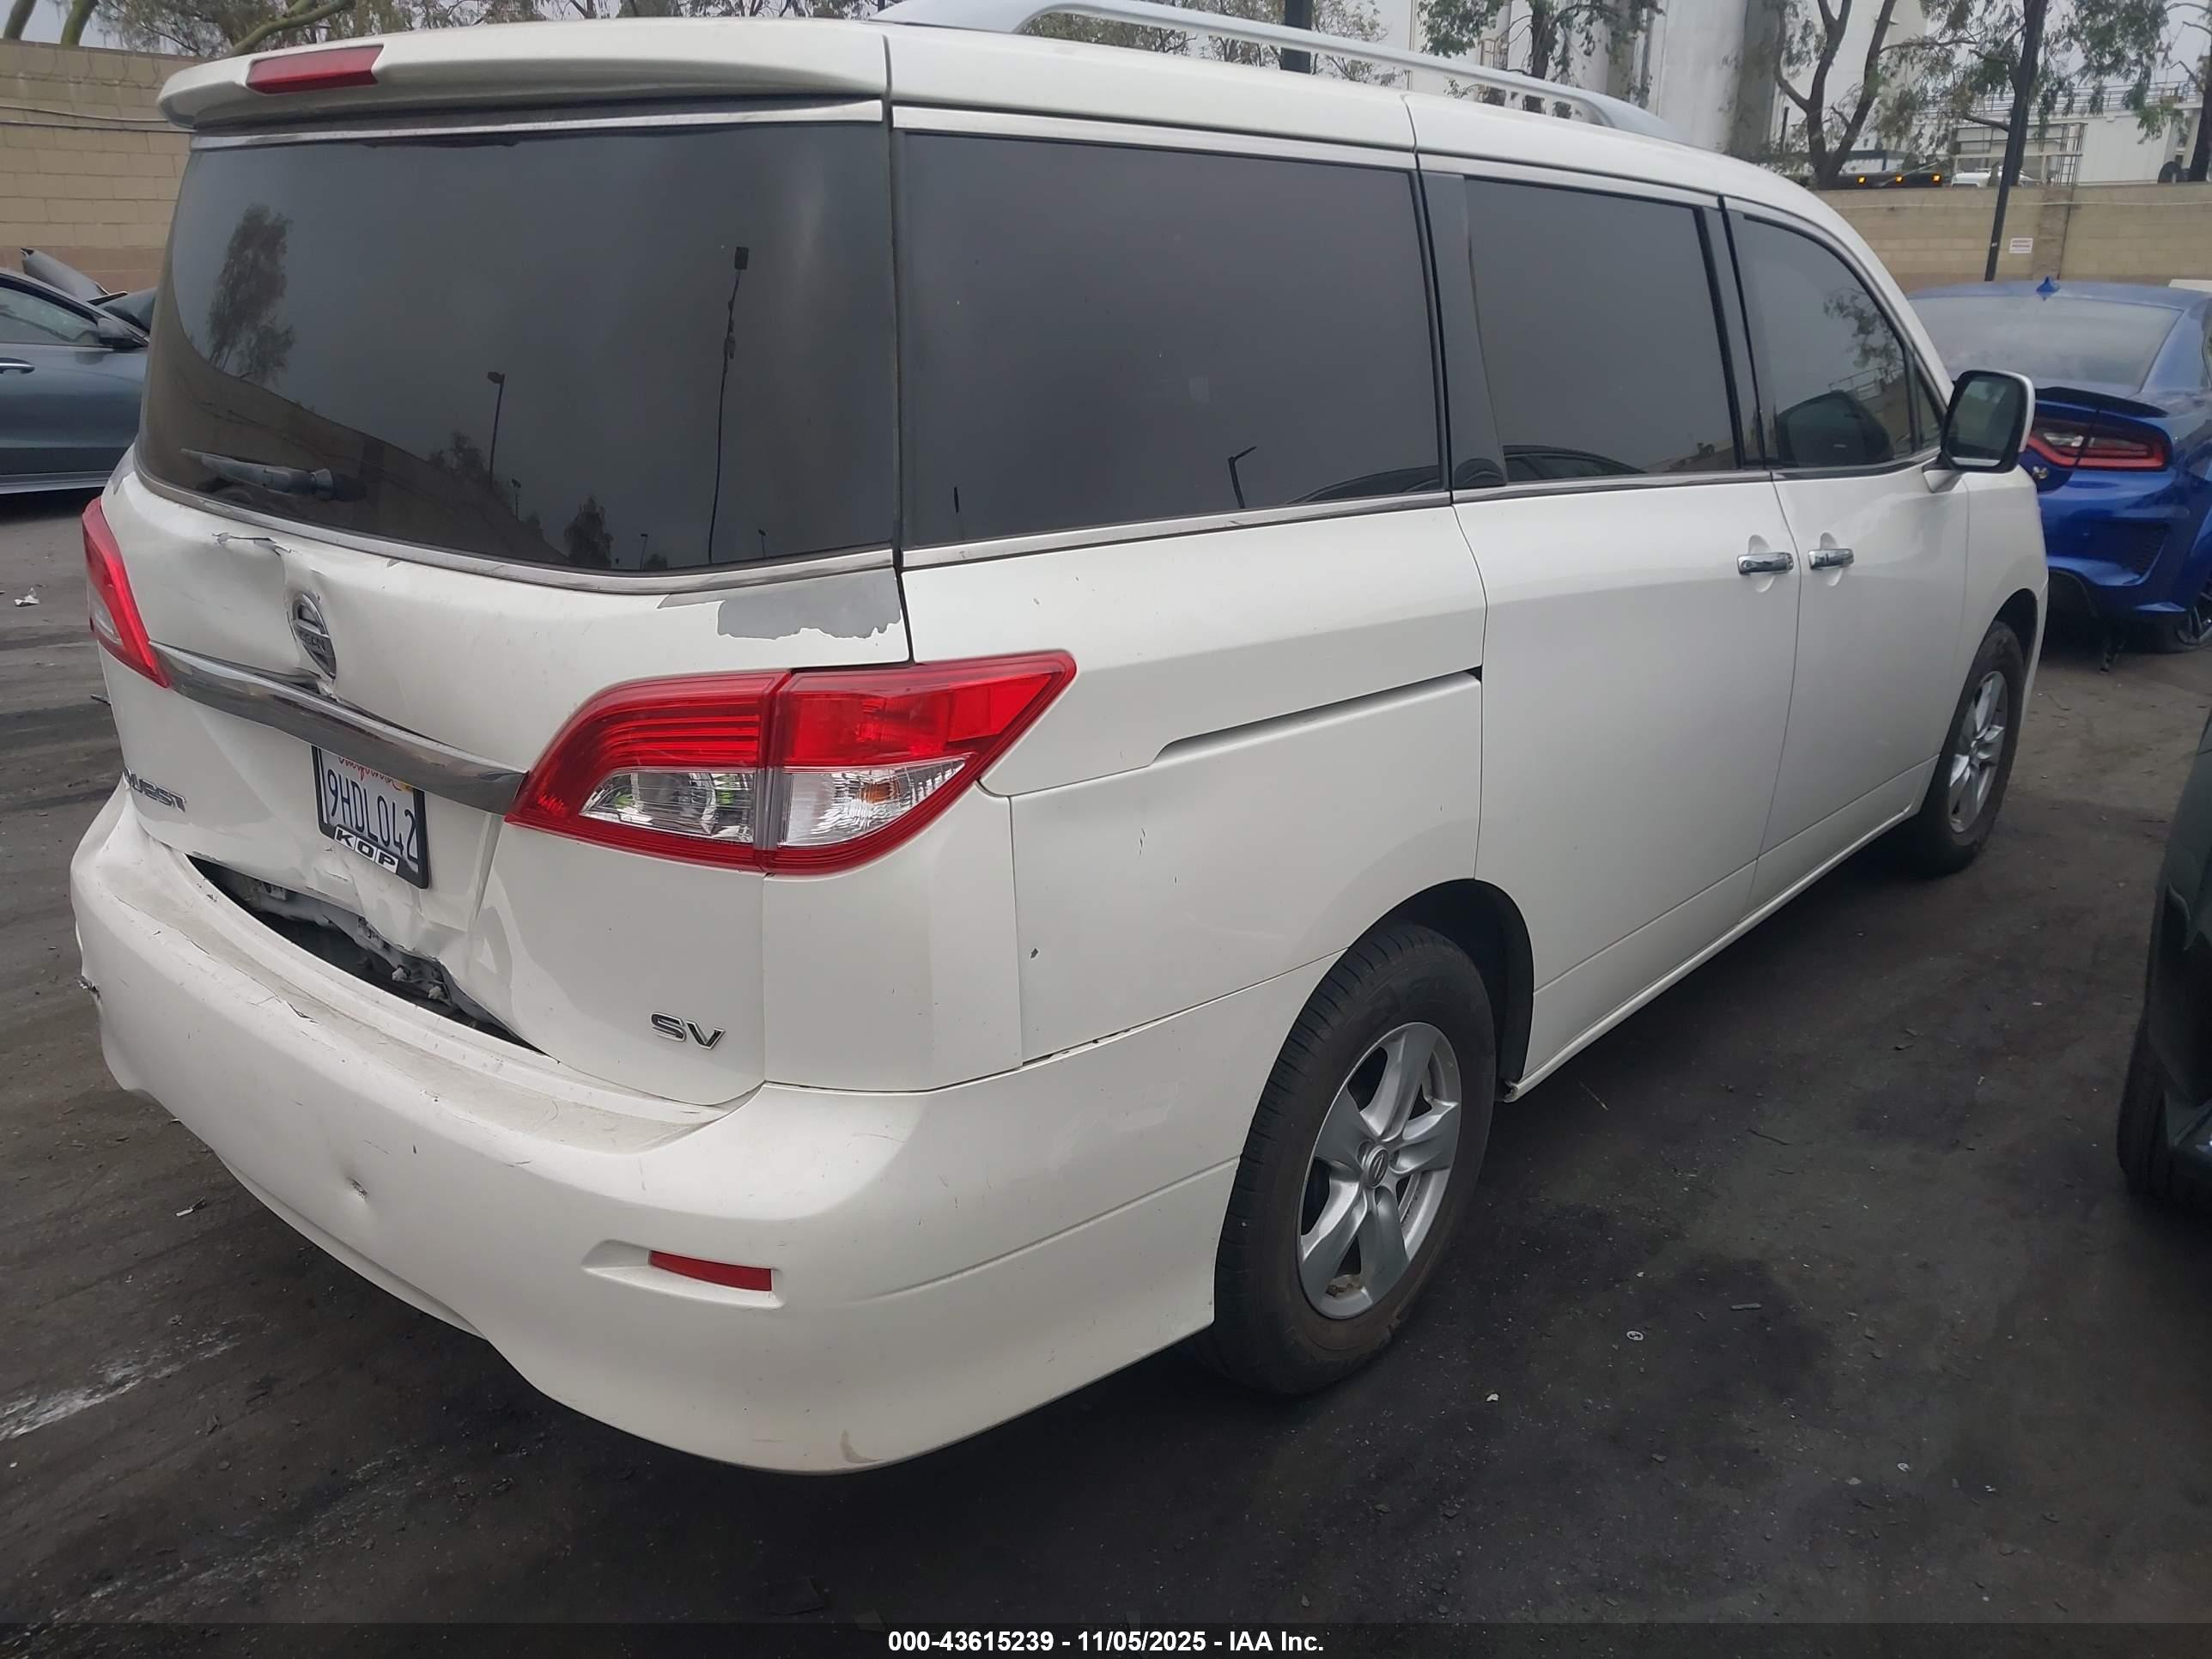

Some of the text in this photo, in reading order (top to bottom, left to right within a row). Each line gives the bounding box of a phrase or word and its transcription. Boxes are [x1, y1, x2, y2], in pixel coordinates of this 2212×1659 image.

[327, 768, 419, 866] 9HDL042
[336, 828, 397, 867] KOP
[650, 1012, 726, 1050] SV
